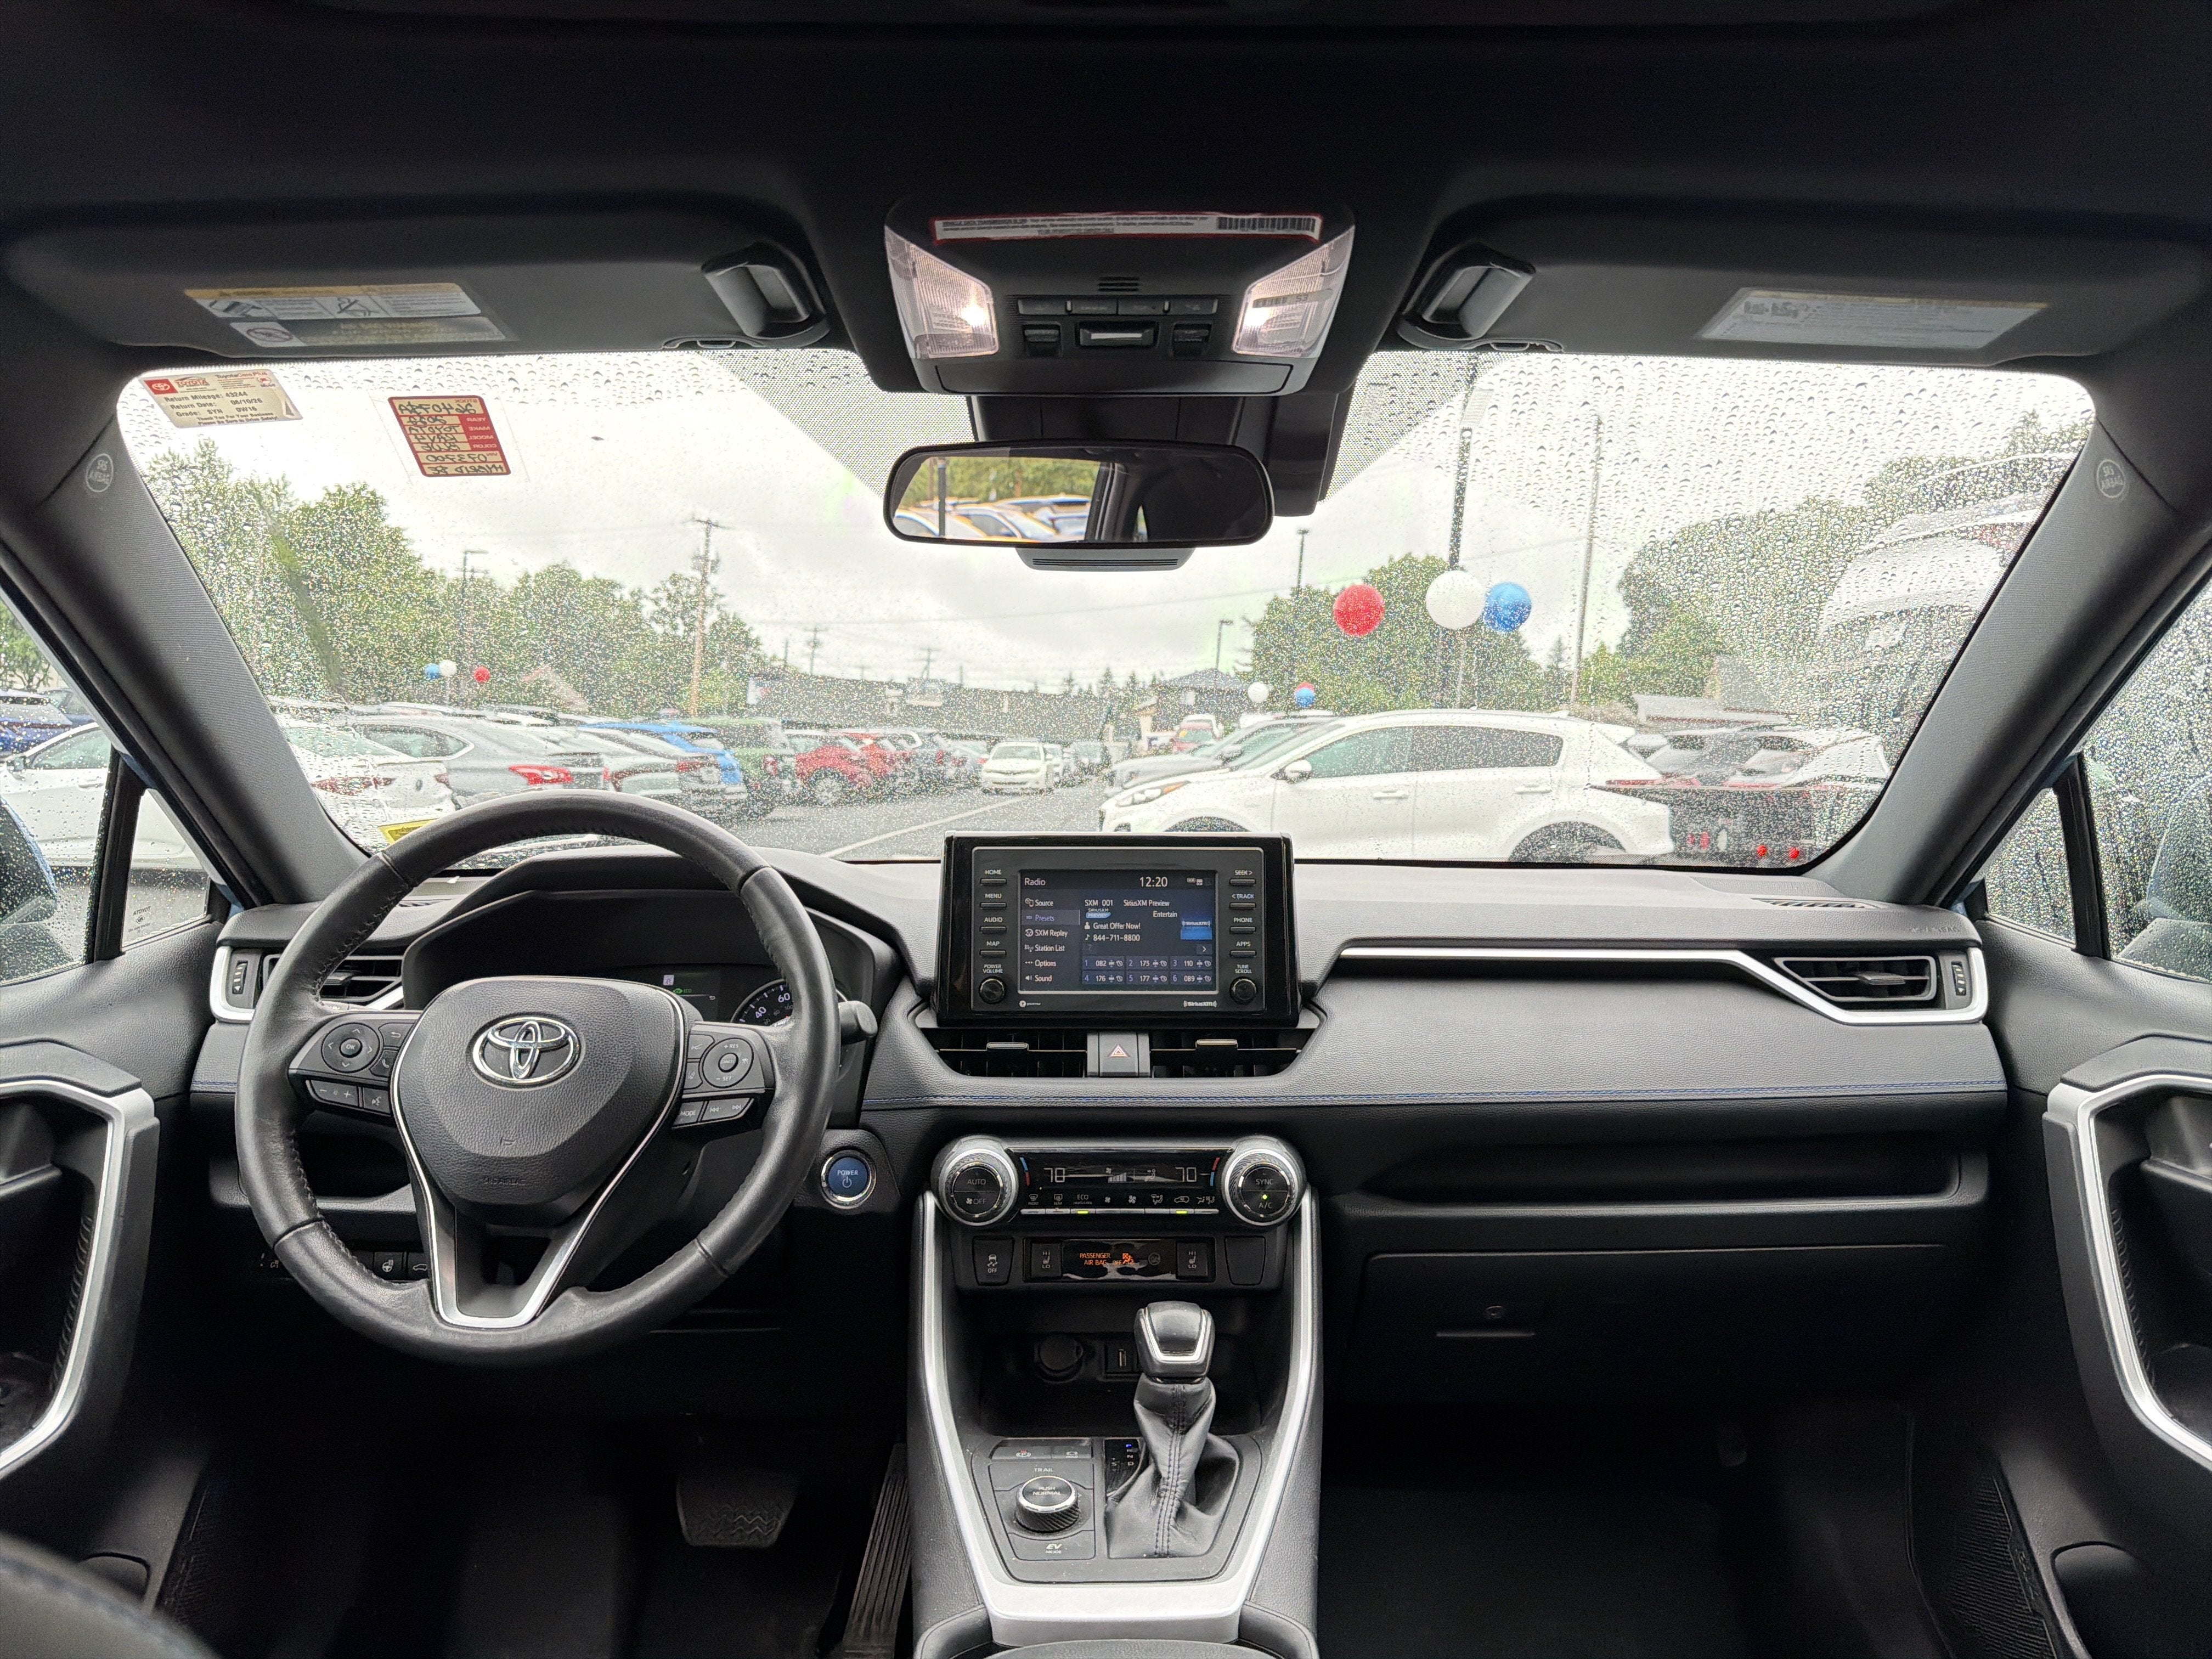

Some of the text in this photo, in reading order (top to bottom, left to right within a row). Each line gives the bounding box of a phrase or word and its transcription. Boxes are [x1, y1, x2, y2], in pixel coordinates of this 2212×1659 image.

[1024, 877, 1168, 887] Radio 12:20
[1049, 929, 1068, 938] Replay
[778, 992, 791, 1003] 60
[755, 1006, 766, 1019] 40
[1175, 1167, 1197, 1182] 70
